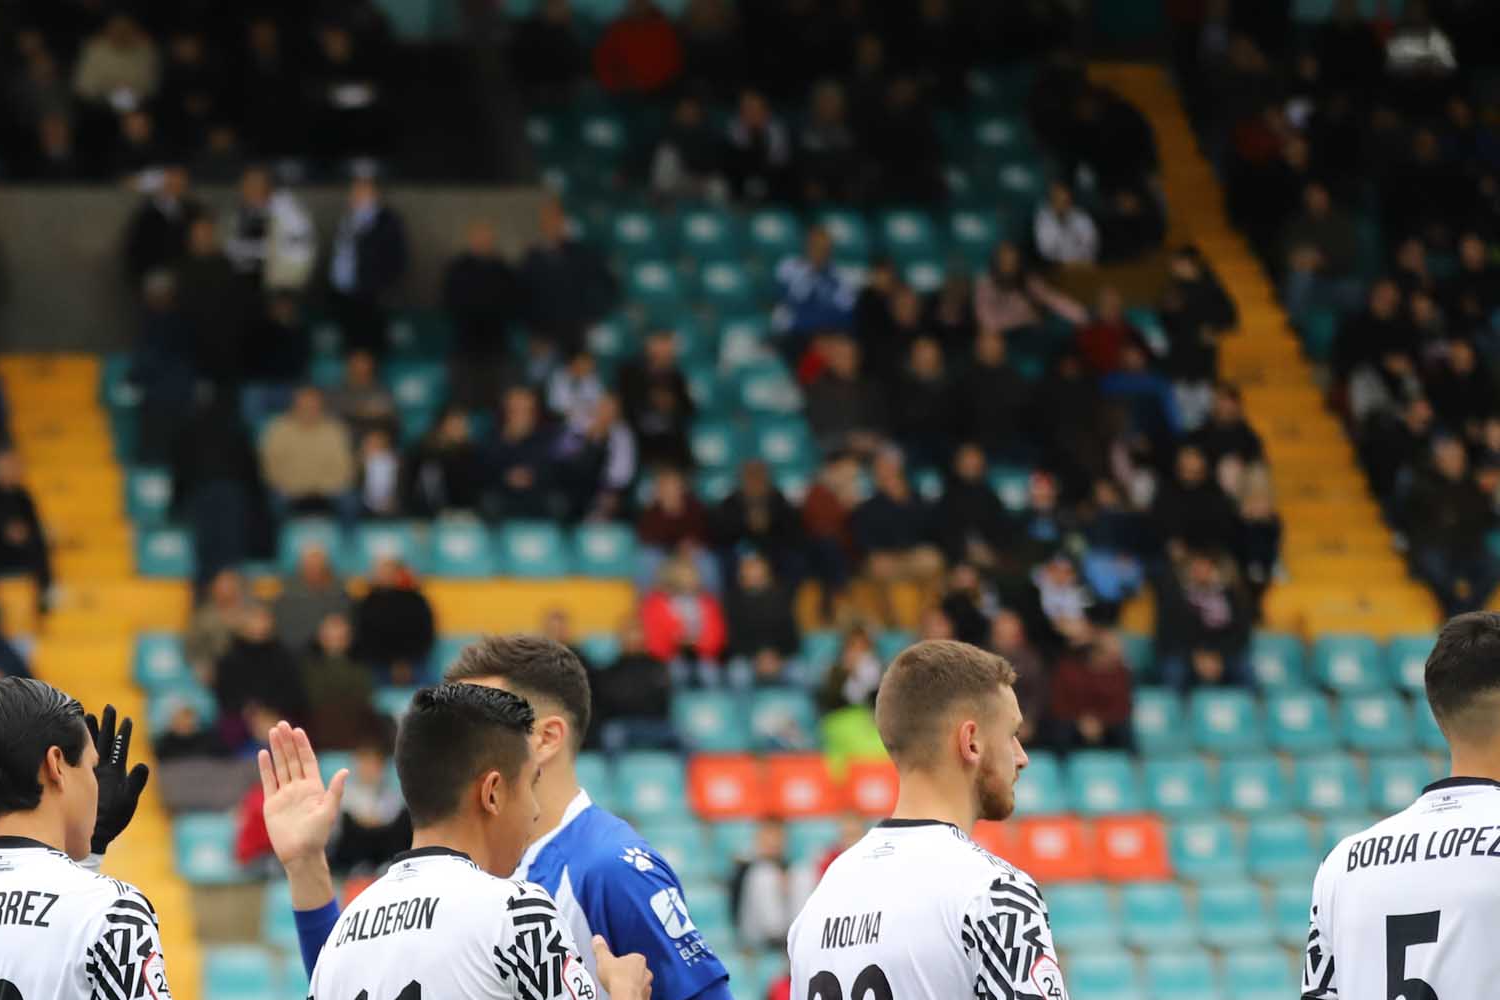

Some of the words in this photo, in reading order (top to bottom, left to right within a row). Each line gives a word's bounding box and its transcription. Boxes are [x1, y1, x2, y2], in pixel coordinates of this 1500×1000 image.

[1347, 835, 1420, 872] BORJA
[336, 897, 440, 947] CALDERON
[821, 911, 882, 949] MOLINA
